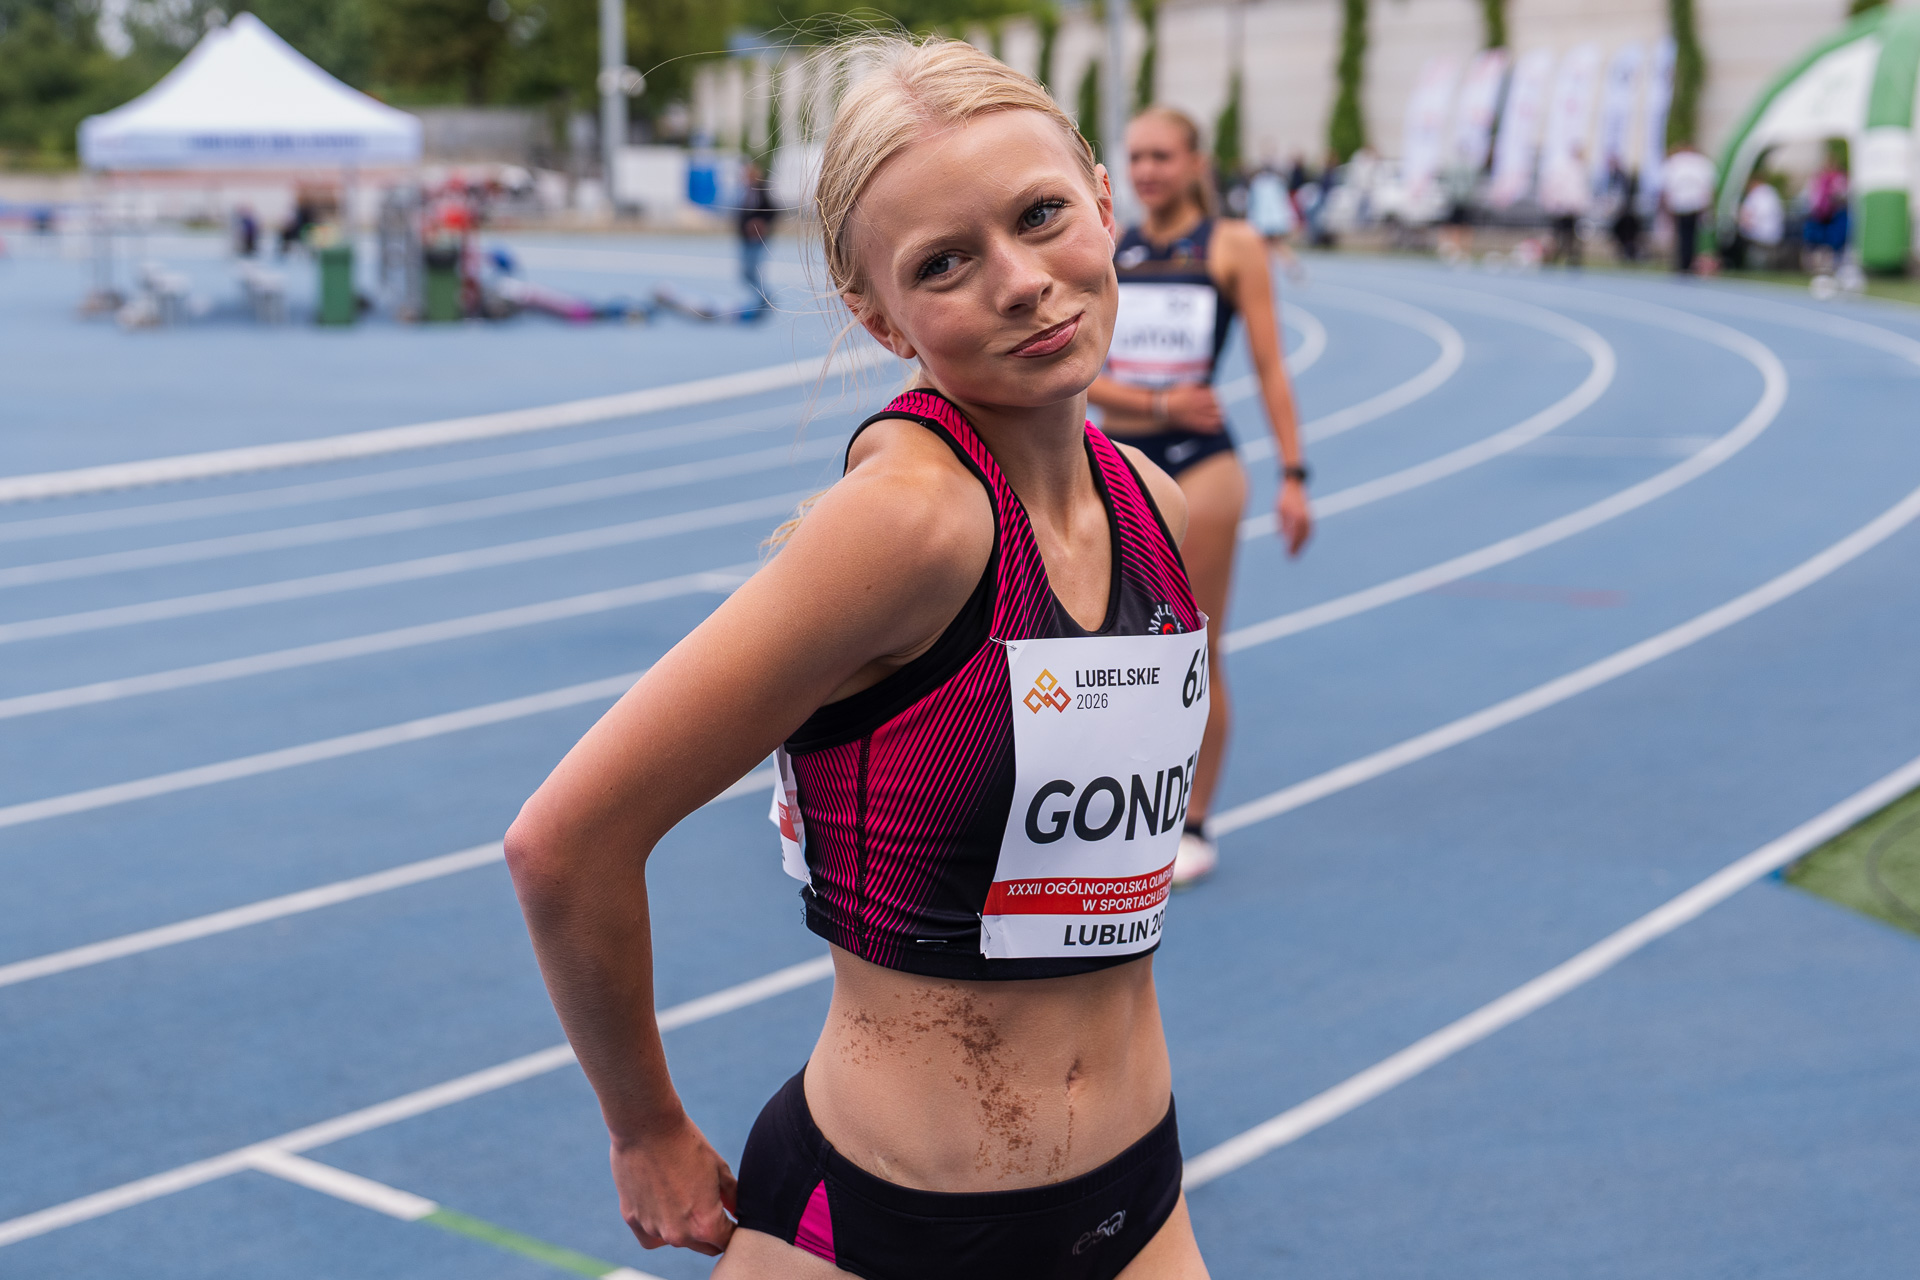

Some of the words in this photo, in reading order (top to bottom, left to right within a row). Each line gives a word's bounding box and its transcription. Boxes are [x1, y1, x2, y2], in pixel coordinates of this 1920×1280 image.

[1075, 667, 1160, 688] LUBELSKIE
[1076, 693, 1109, 710] 2026
[1024, 751, 1197, 844] GONDE
[1007, 883, 1042, 896] XXXII
[1044, 879, 1148, 895] OGÓLNOPOLSKA
[1082, 899, 1098, 912] W
[1099, 891, 1157, 912] SPORTACH
[1063, 919, 1150, 946] LUBLIN
